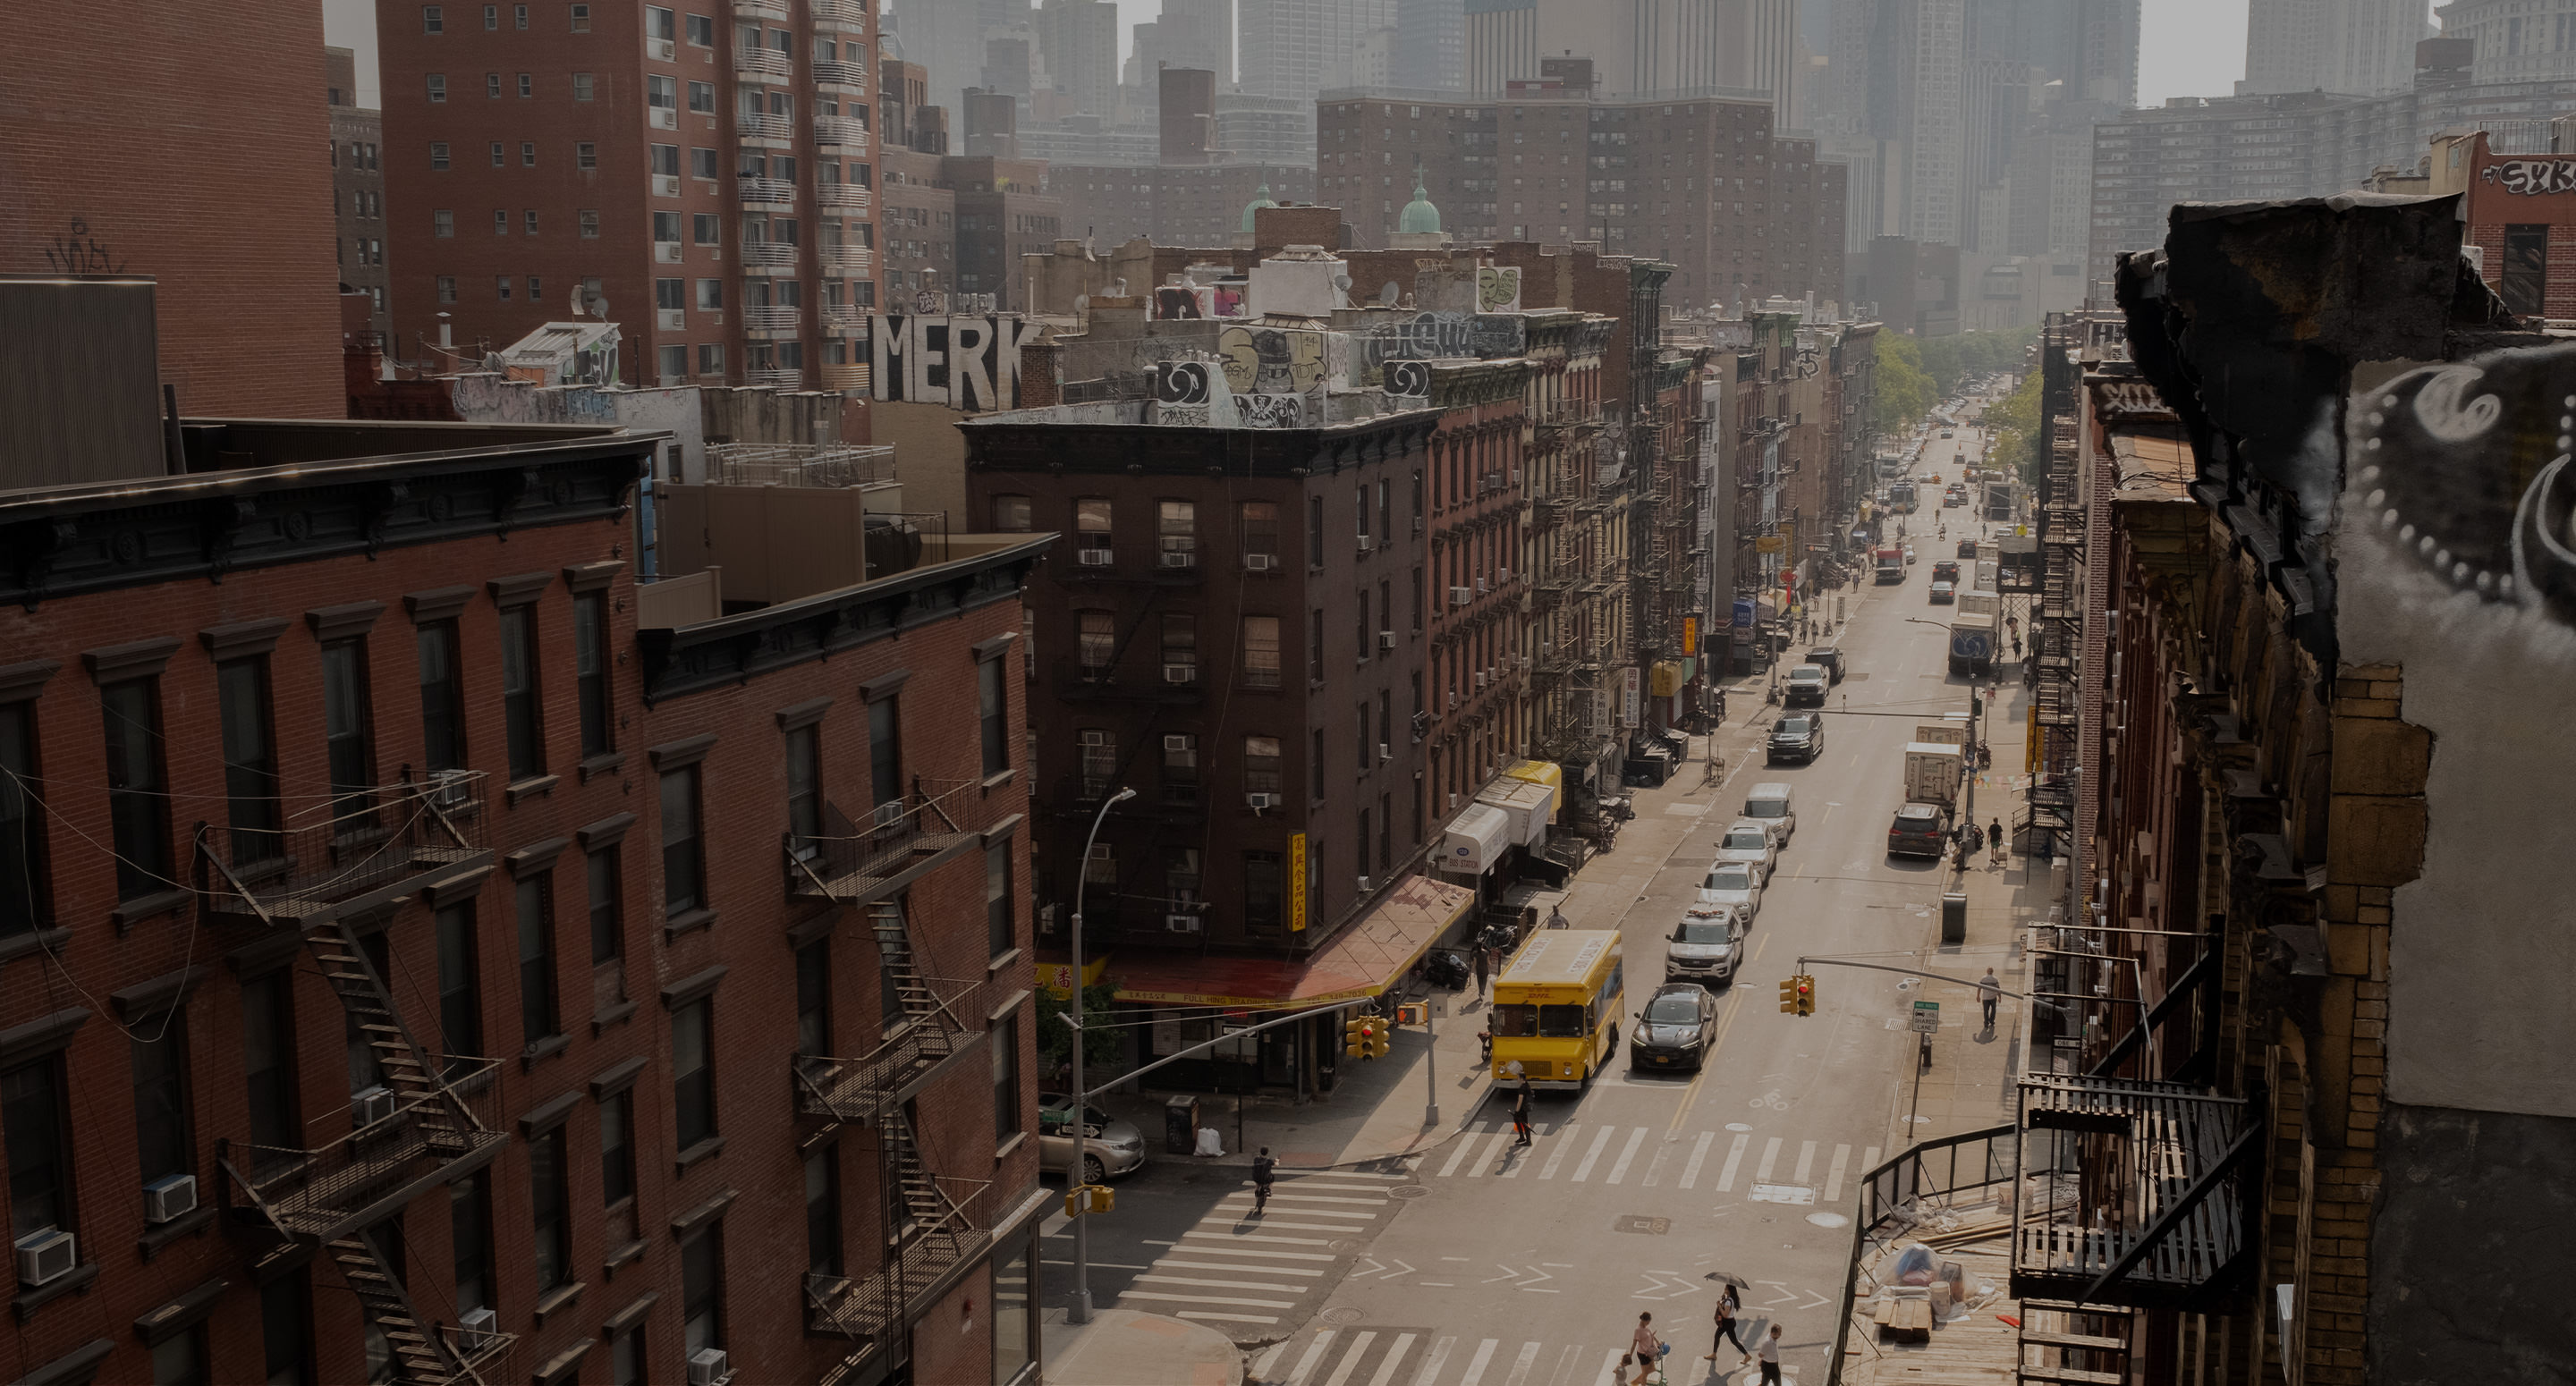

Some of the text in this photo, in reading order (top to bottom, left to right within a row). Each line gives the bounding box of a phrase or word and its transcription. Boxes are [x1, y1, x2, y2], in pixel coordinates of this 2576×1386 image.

[2500, 160, 2576, 194] SYK
[872, 315, 1040, 411] MERK
[1449, 858, 1479, 869] BUS STATION
[1183, 994, 1205, 1003] FULL
[1207, 996, 1226, 1005] HING
[1229, 997, 1267, 1007] TRADING
